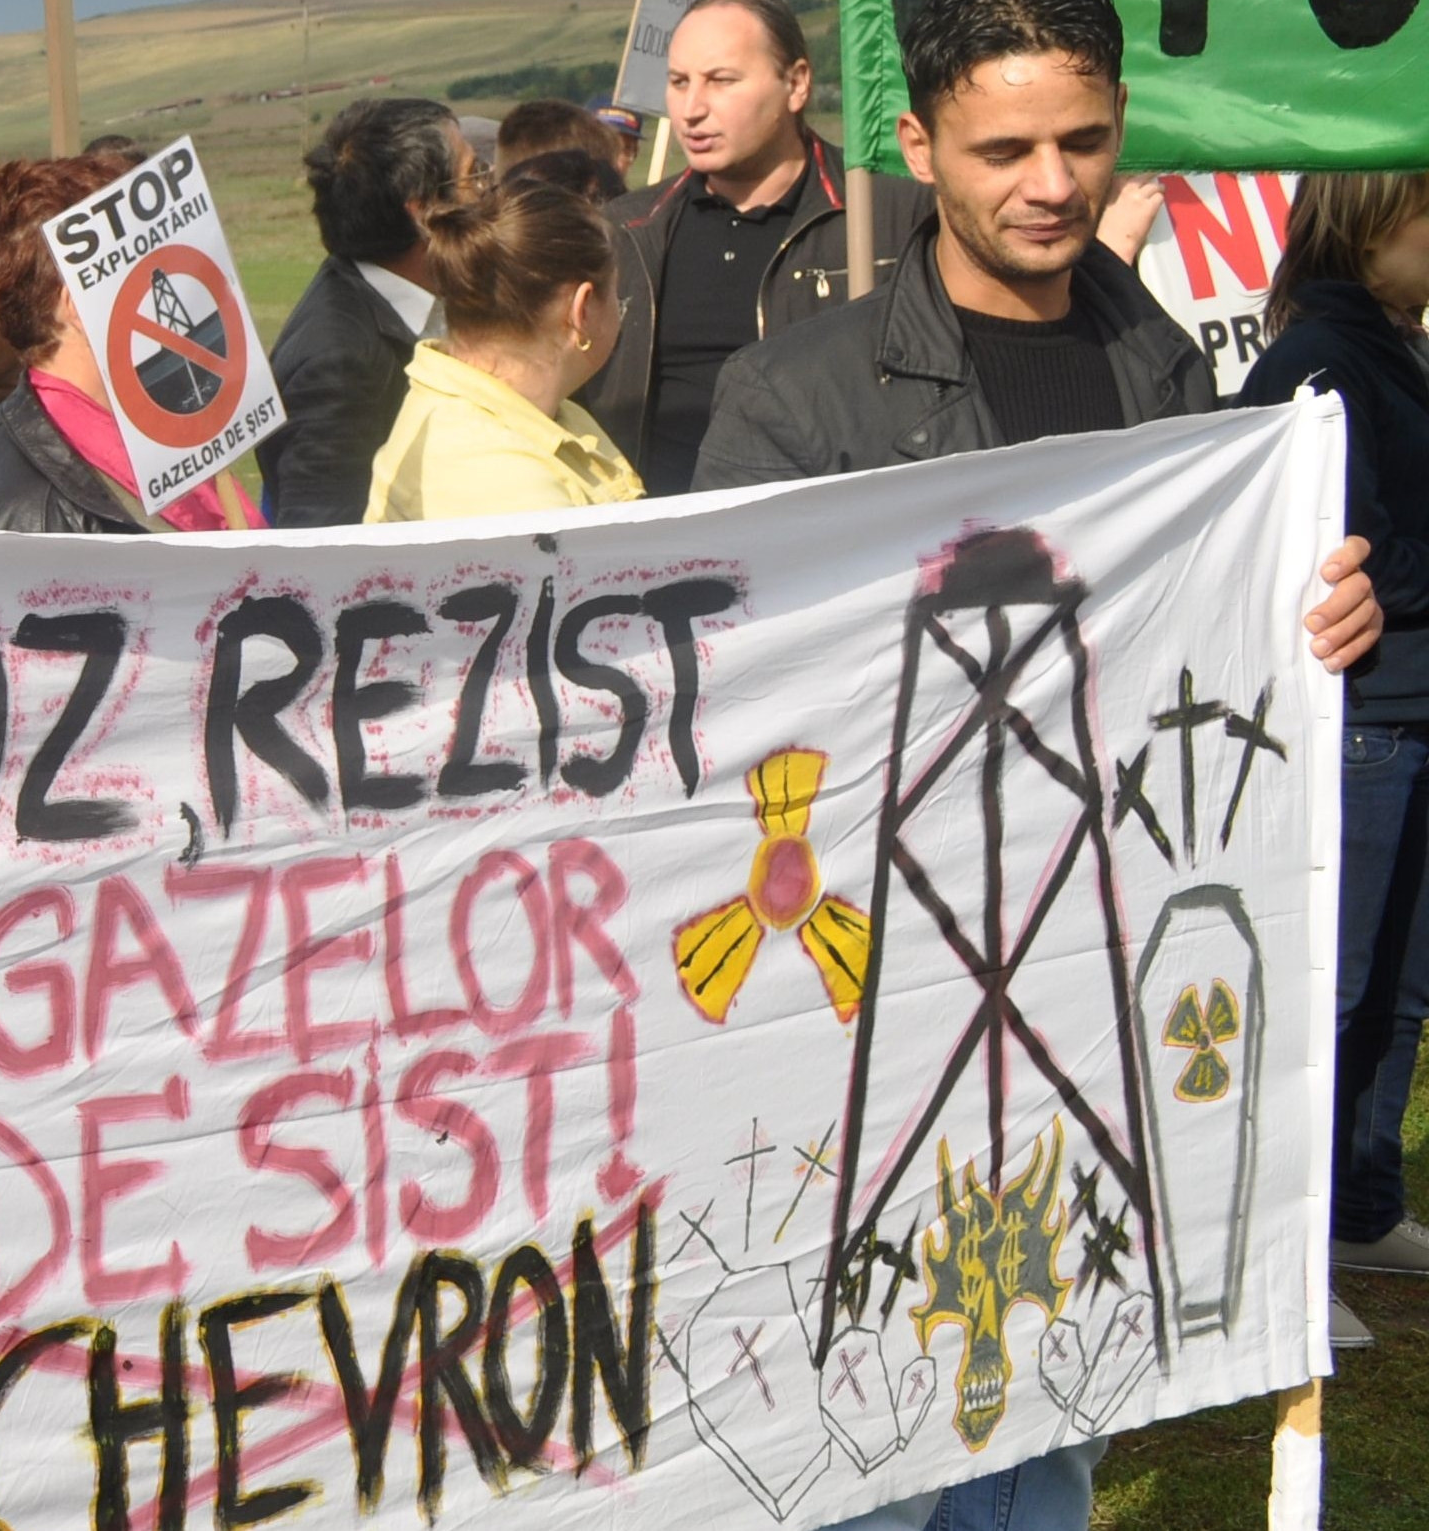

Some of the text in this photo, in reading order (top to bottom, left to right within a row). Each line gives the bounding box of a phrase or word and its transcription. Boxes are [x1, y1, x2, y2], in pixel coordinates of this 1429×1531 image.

[55, 146, 194, 266] STOP
[76, 192, 209, 291] EXPLOATĂRII
[147, 442, 225, 500] GAZELOR
[227, 421, 246, 452] DE
[203, 532, 745, 842] REZIST
